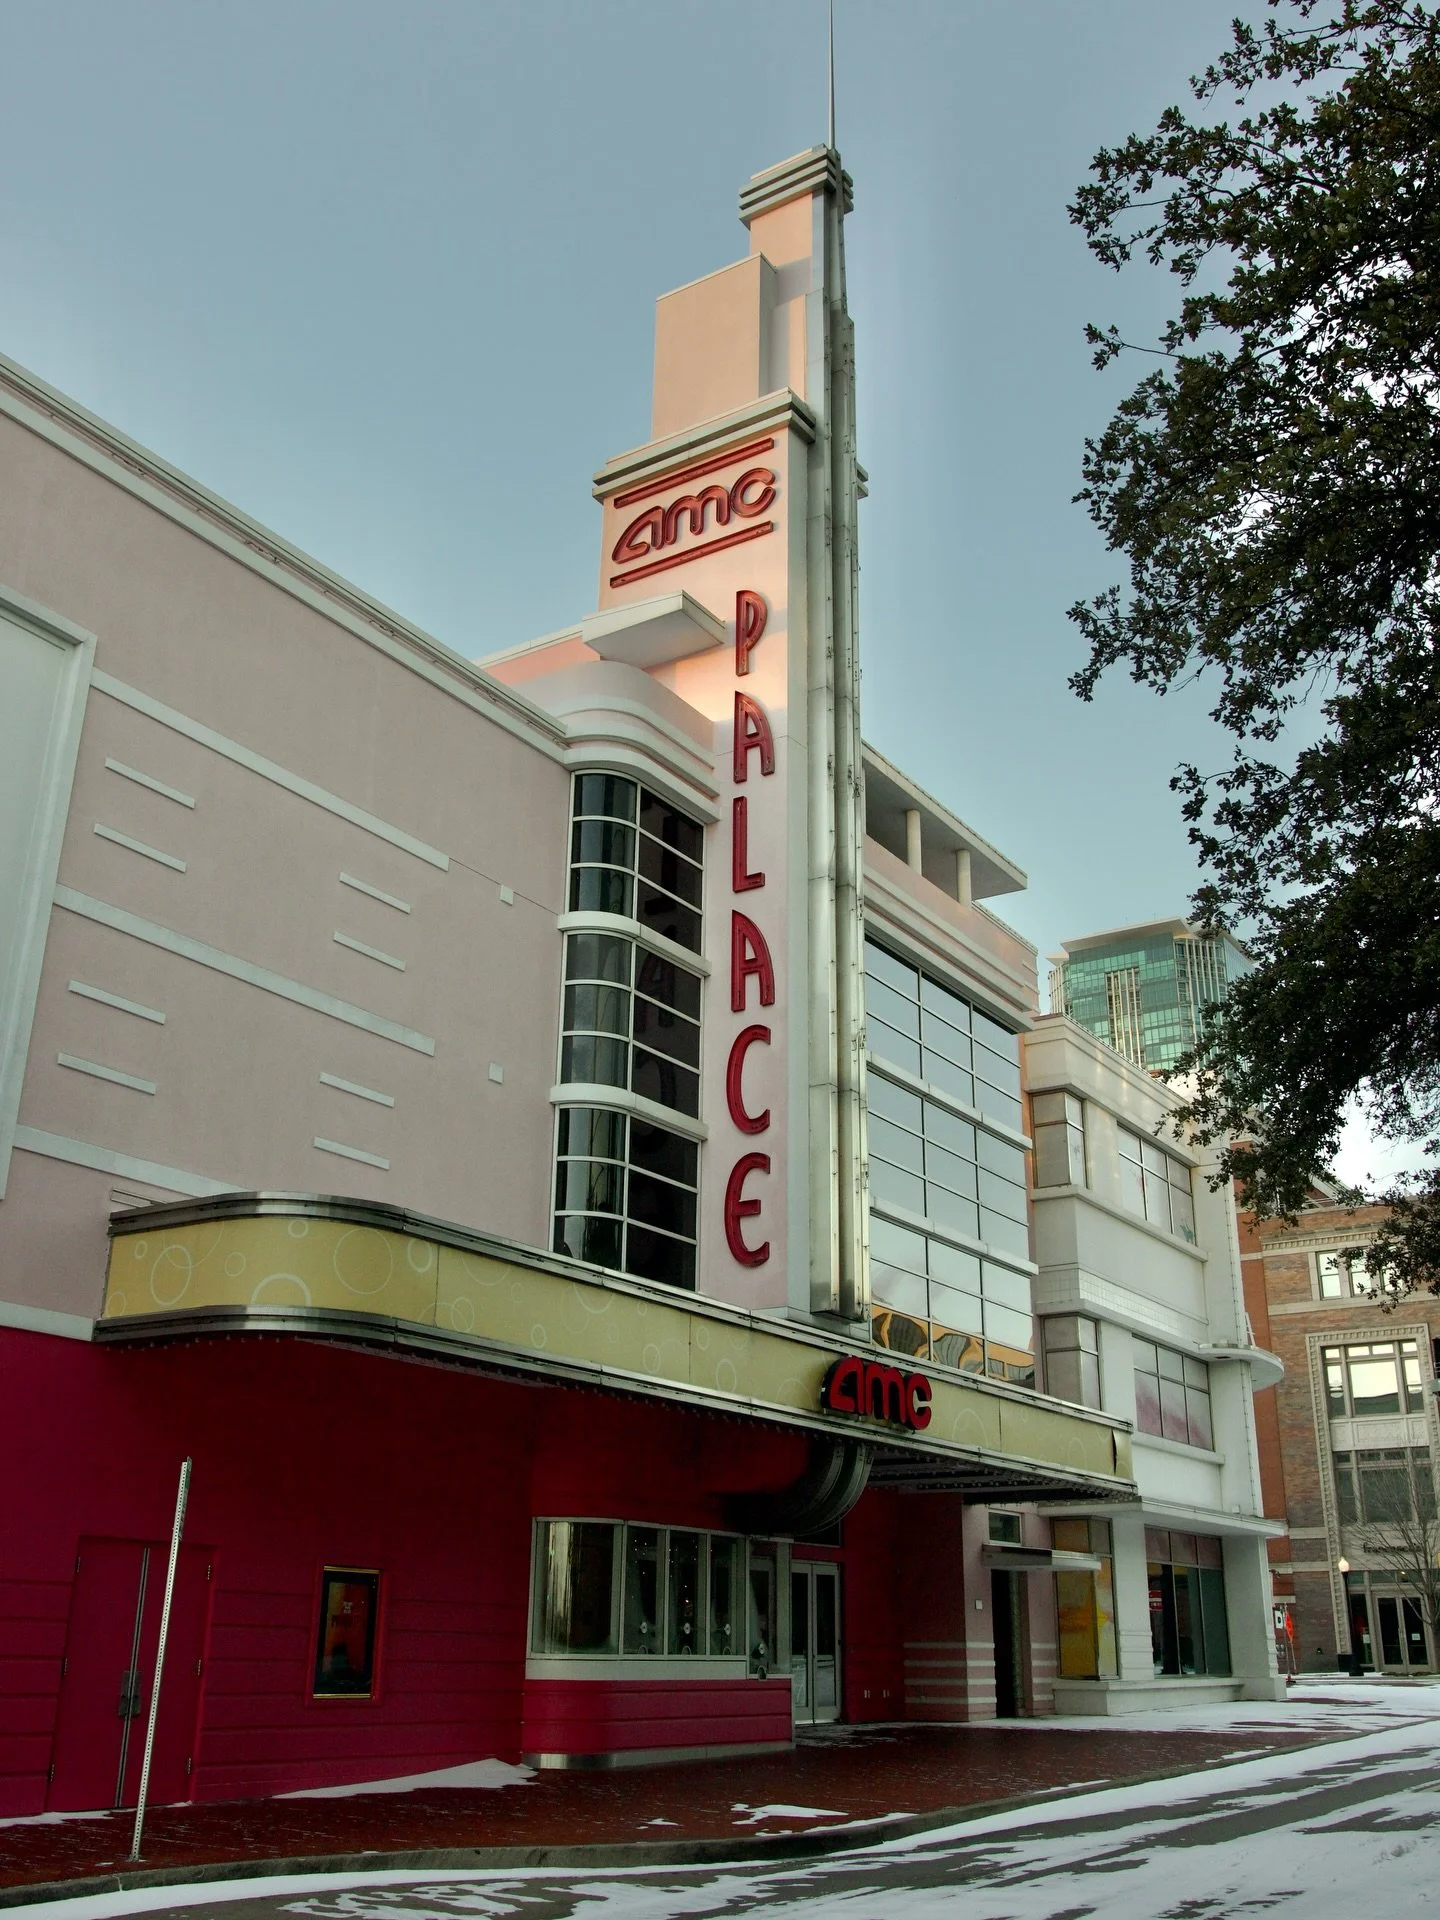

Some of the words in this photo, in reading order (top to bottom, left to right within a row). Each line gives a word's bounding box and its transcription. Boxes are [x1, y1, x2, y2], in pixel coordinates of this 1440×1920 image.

[612, 467, 776, 564] amc
[724, 590, 776, 1268] PALACE
[821, 1355, 932, 1430] amc
